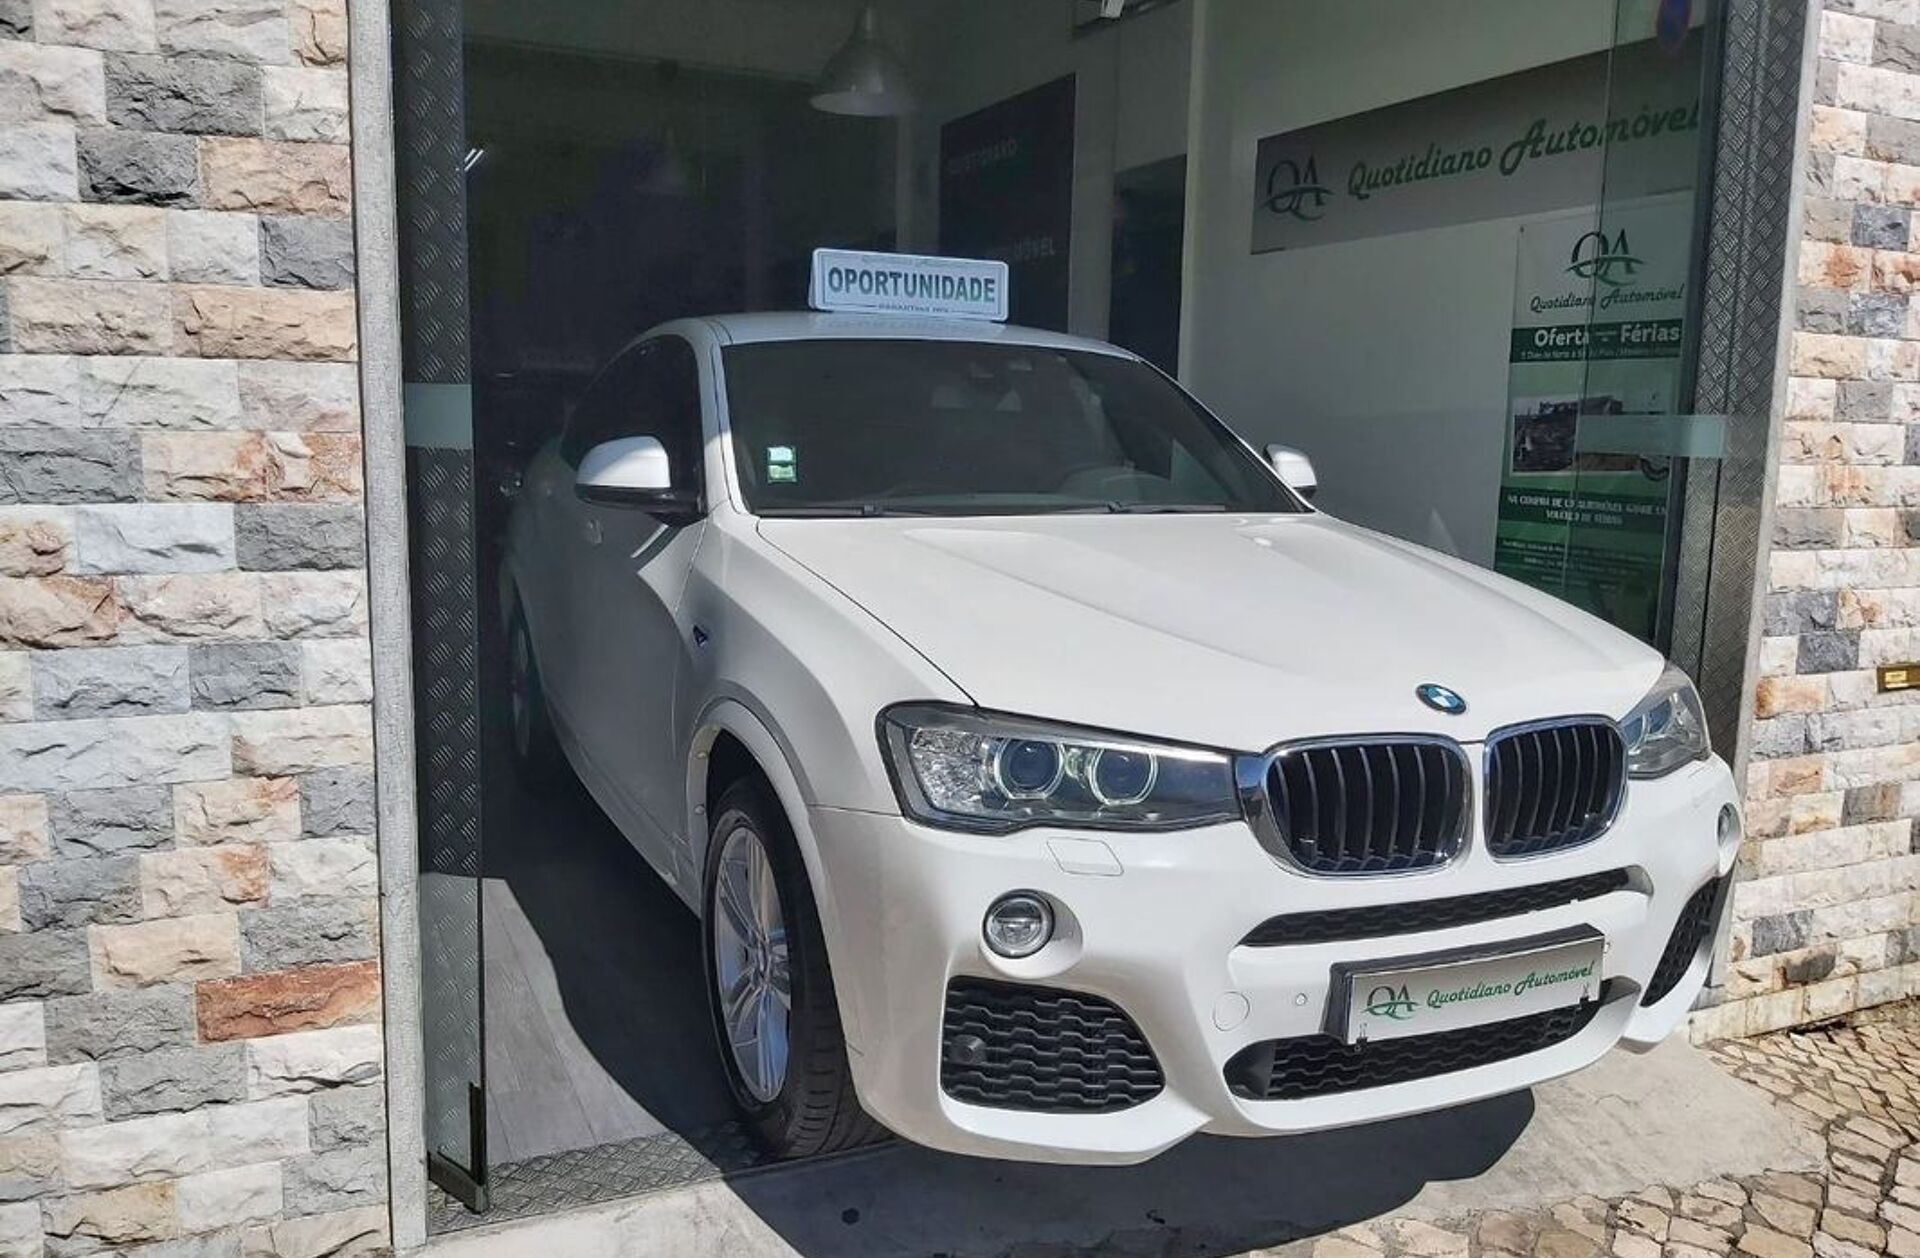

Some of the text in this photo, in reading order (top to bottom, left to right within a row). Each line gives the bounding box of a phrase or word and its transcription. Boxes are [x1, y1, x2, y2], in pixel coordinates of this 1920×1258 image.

[1347, 96, 1699, 199] Quotidiano Automóvel
[828, 267, 995, 303] OPORTUNIDADE
[1621, 323, 1680, 343] Férias
[1426, 960, 1596, 1009] Quotidiano Automóvel
